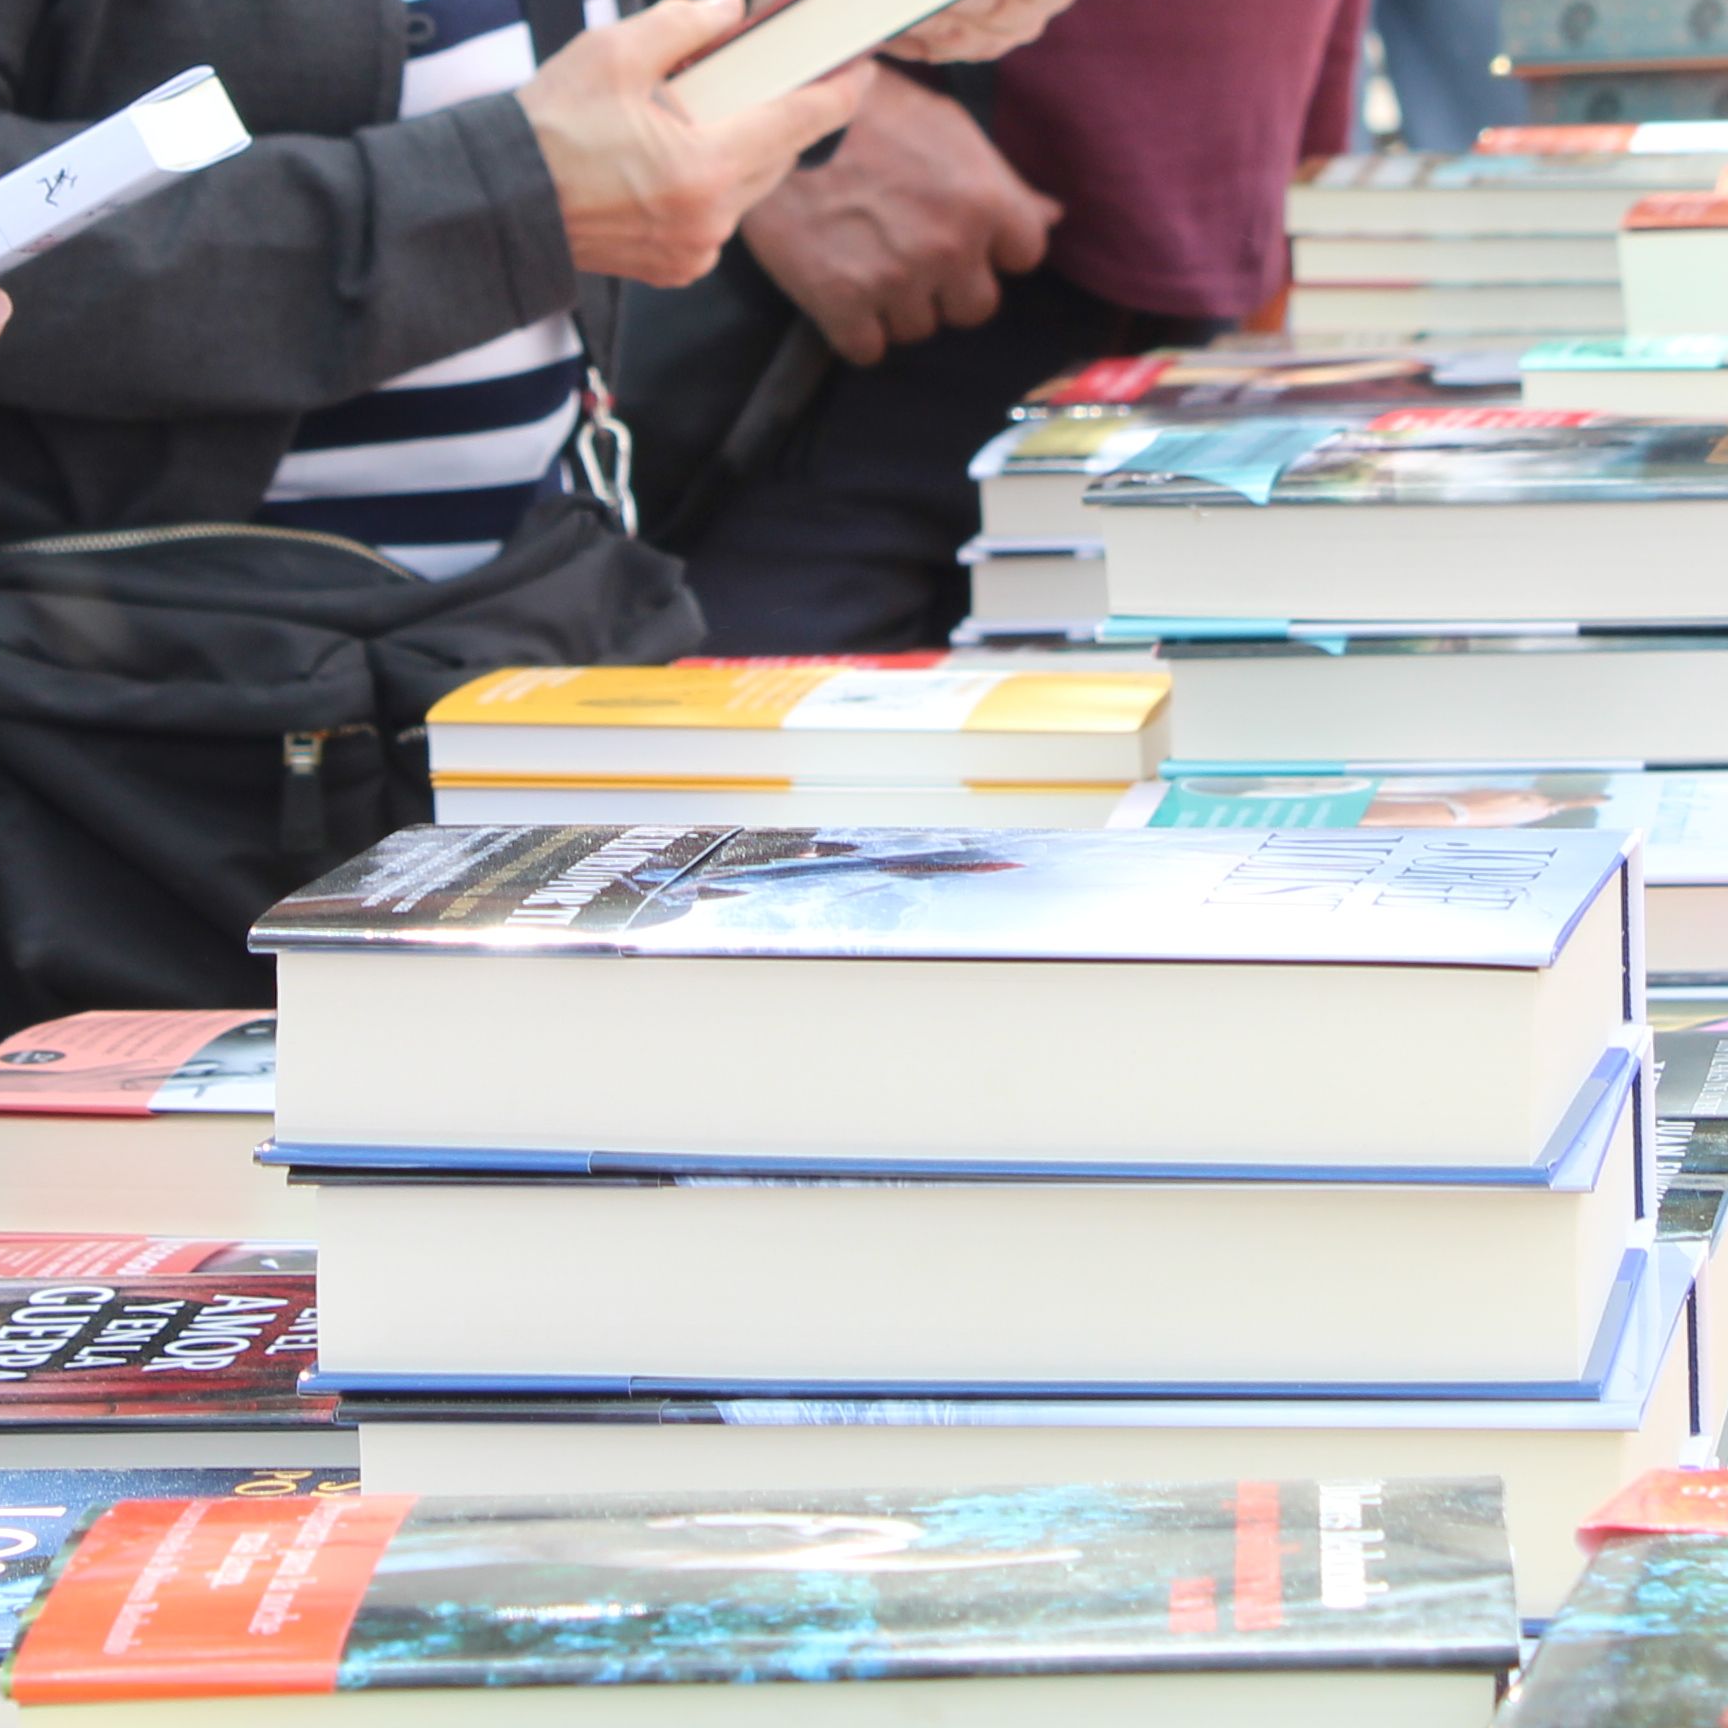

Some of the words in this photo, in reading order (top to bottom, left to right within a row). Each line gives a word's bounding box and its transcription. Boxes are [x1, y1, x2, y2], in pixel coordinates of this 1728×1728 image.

[1373, 840, 1559, 910] JORGE
[1655, 1120, 1696, 1157] JUAN
[122, 1300, 186, 1315] Y
[92, 1317, 170, 1343] EN
[141, 1293, 290, 1372] AMOR
[63, 1344, 143, 1370] LA
